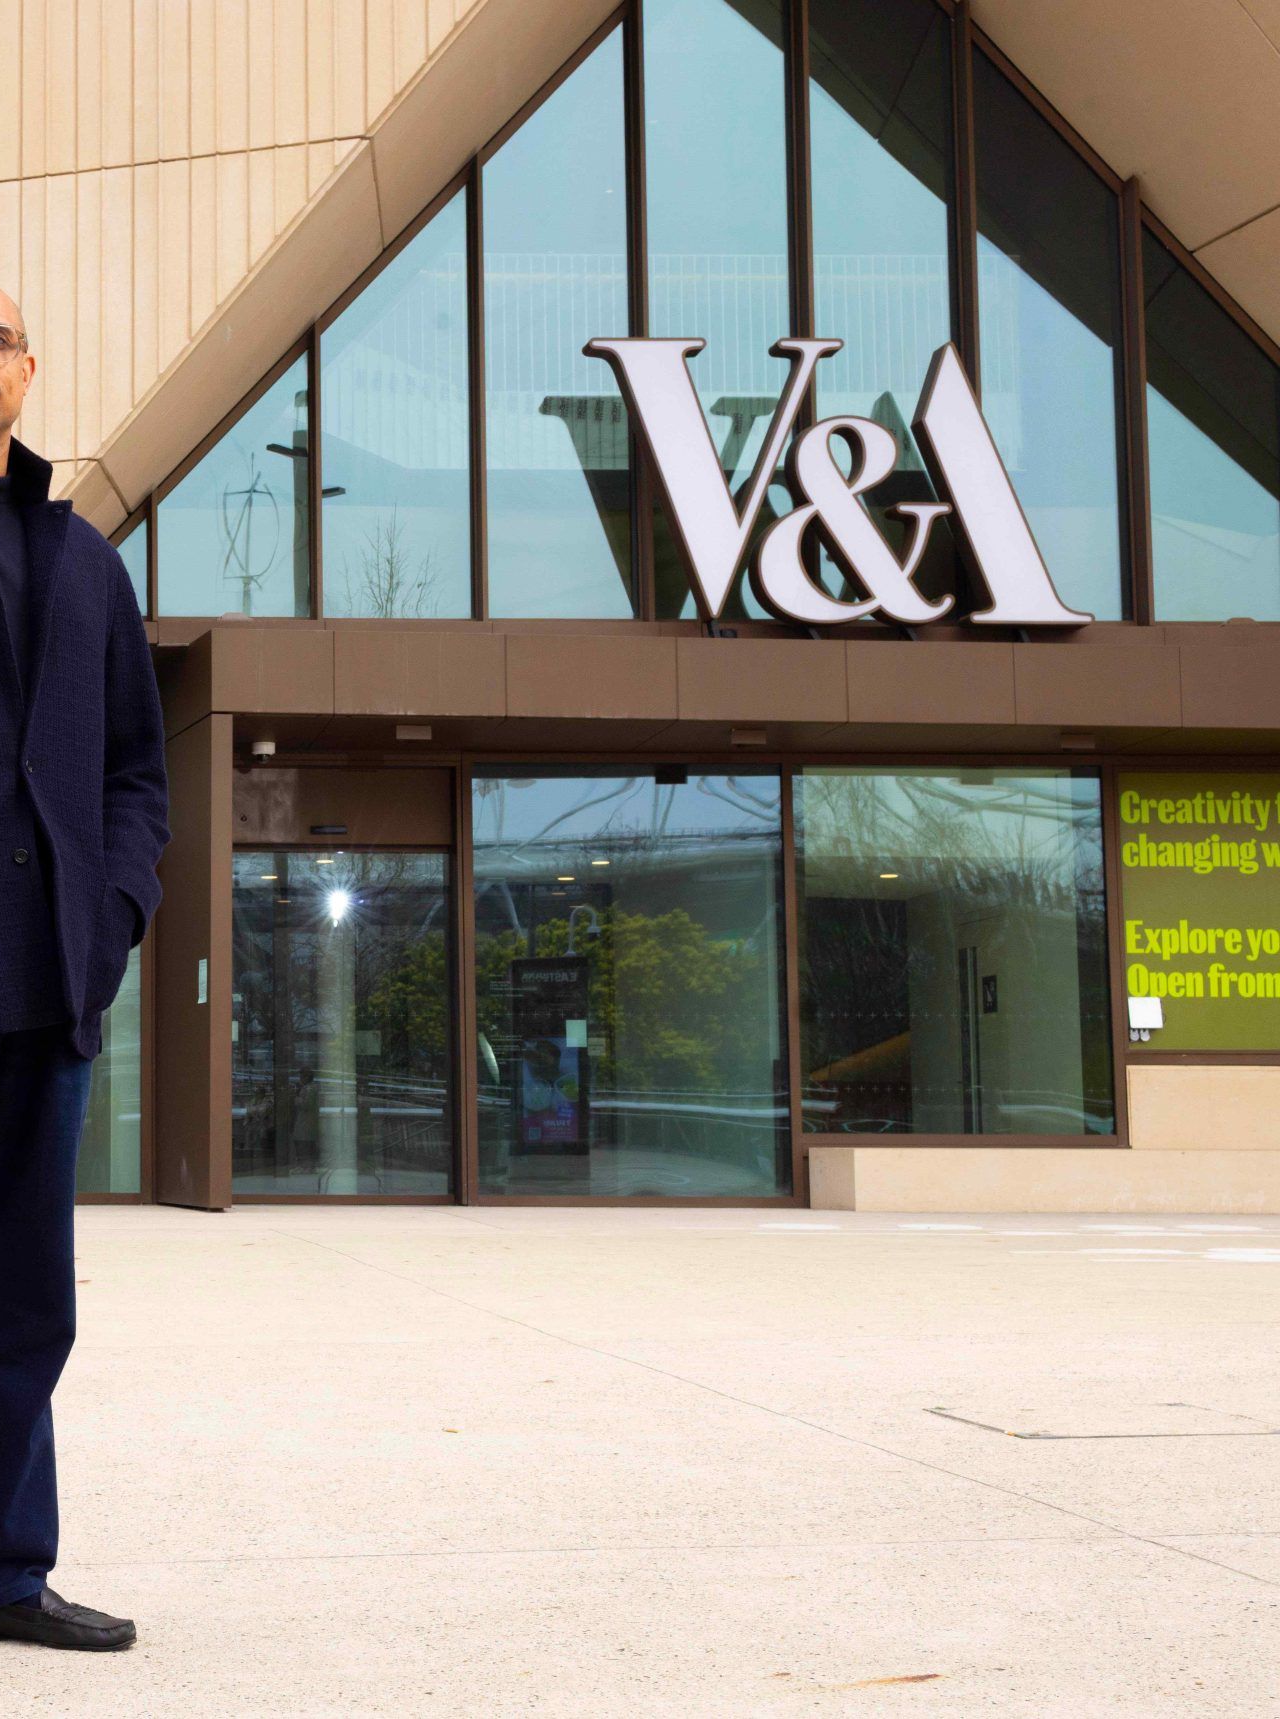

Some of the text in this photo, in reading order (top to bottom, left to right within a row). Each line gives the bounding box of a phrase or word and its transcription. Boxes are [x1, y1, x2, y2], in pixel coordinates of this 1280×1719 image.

[582, 337, 1095, 630] V&A
[1121, 790, 1270, 831] Creativity
[1123, 833, 1259, 874] changing
[1126, 919, 1280, 961] Explore yo
[1127, 963, 1280, 998] Open from
